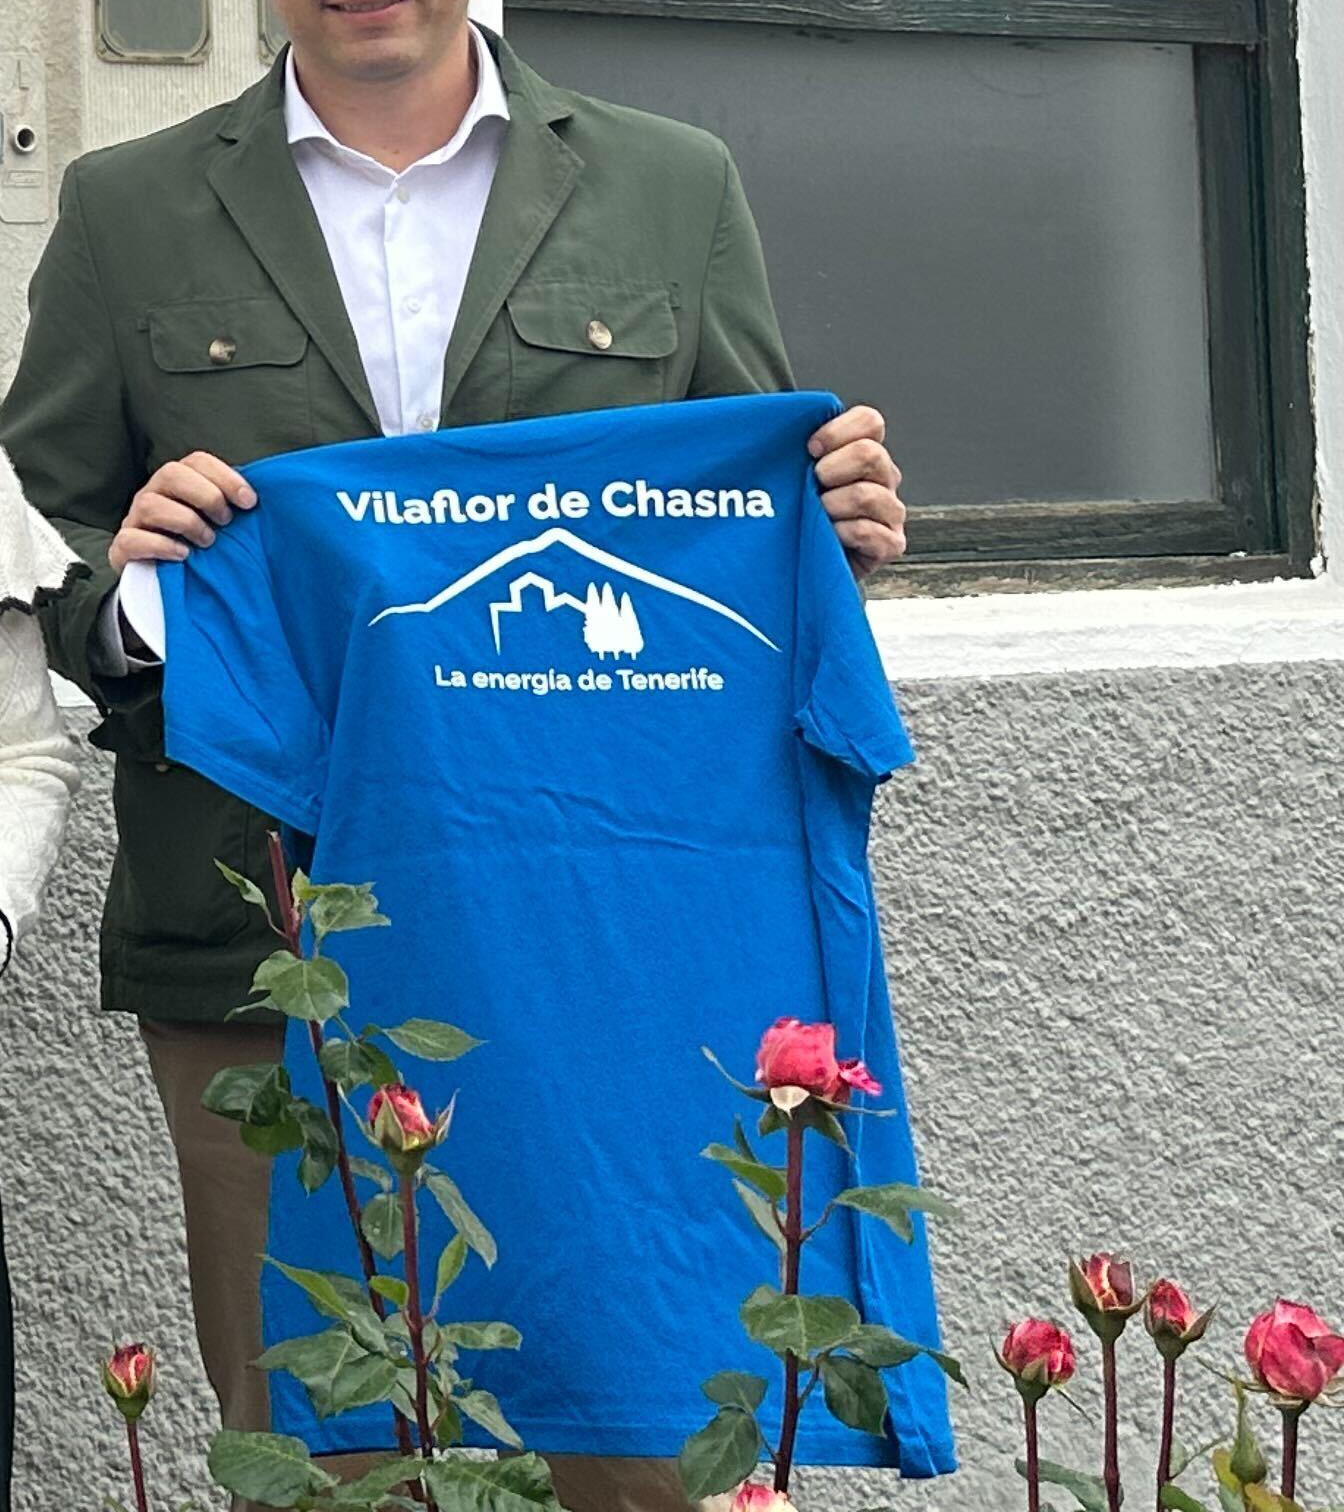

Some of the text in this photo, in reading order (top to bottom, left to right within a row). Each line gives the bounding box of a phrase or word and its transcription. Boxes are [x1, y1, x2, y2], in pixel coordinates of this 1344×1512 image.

[336, 479, 776, 525] Vilaflor de Chasna
[434, 664, 467, 688] La
[576, 667, 613, 691] de
[614, 666, 725, 691] Tenerife
